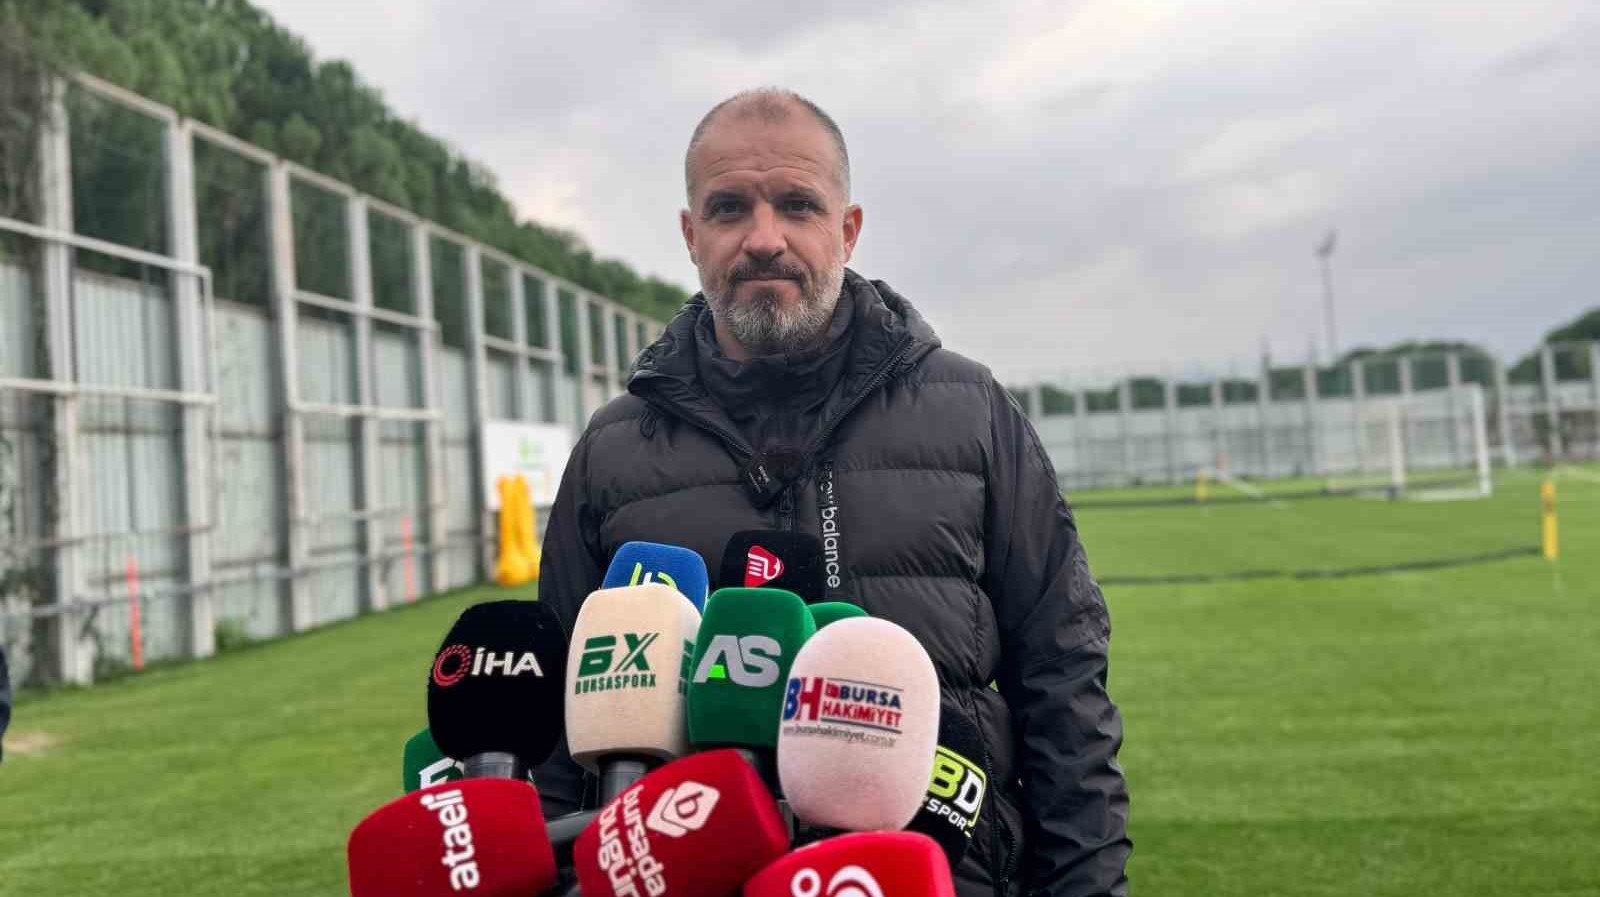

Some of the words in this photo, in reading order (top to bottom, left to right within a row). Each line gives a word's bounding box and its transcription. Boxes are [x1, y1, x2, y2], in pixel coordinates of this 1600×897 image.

[822, 506, 841, 588] balance
[472, 647, 543, 677] İHA
[578, 632, 658, 677] BX
[693, 635, 782, 687] AS
[575, 673, 656, 694] BURSASPORX
[840, 685, 902, 709] BURSA
[624, 784, 667, 897] bursada
